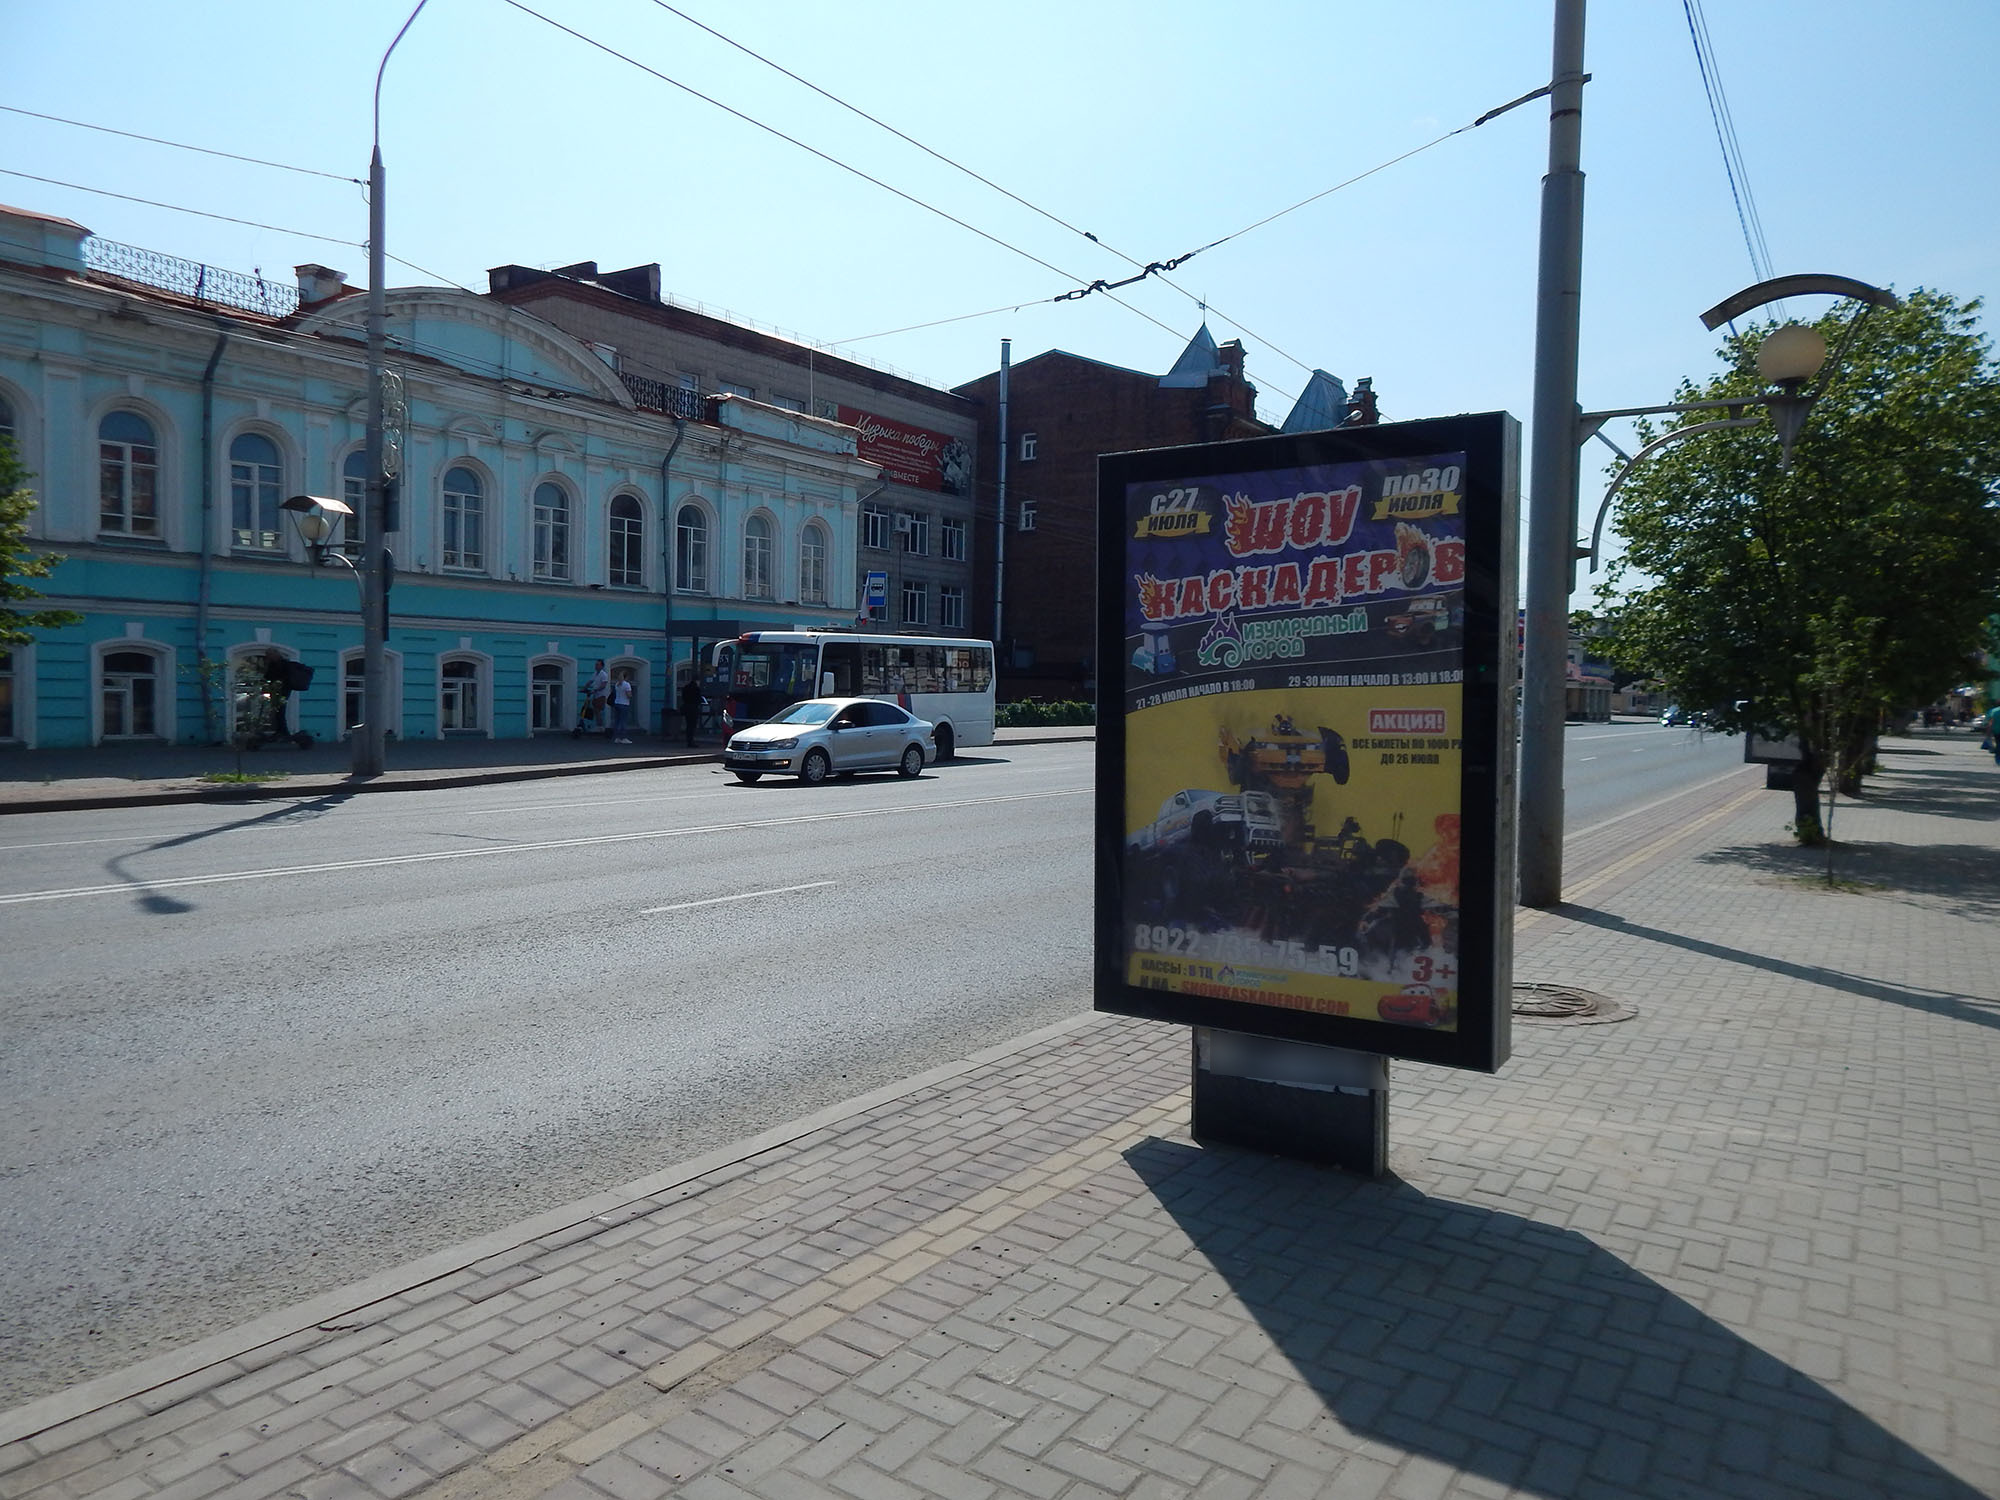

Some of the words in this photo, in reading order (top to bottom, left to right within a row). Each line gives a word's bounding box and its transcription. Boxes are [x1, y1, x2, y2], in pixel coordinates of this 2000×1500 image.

[855, 414, 901, 444] Музыка
[1388, 493, 1445, 513] ИЮЛЯ
[1147, 512, 1199, 532] ИЮЛЯ
[1242, 607, 1369, 641] ИЗУМРУДНЫЙ
[1243, 636, 1306, 661] ГОРОД
[736, 673, 747, 685] 12
[1320, 674, 1349, 687] ИЮЛЯ
[1351, 673, 1390, 686] НАЧАЛО
[1391, 673, 1400, 685] В
[1402, 672, 1429, 685] 13:00
[1161, 687, 1188, 703] ИЮЛЯ
[1188, 681, 1222, 698] НАЧАЛО
[1230, 678, 1255, 692] 18:00
[1372, 713, 1444, 731] АКЦИЯ!
[1352, 738, 1370, 749] ВСЕ
[1371, 738, 1410, 749] БИЛЕТЫ
[1380, 753, 1395, 766] ДО
[1396, 753, 1409, 765] 26
[1411, 955, 1457, 983] 3+
